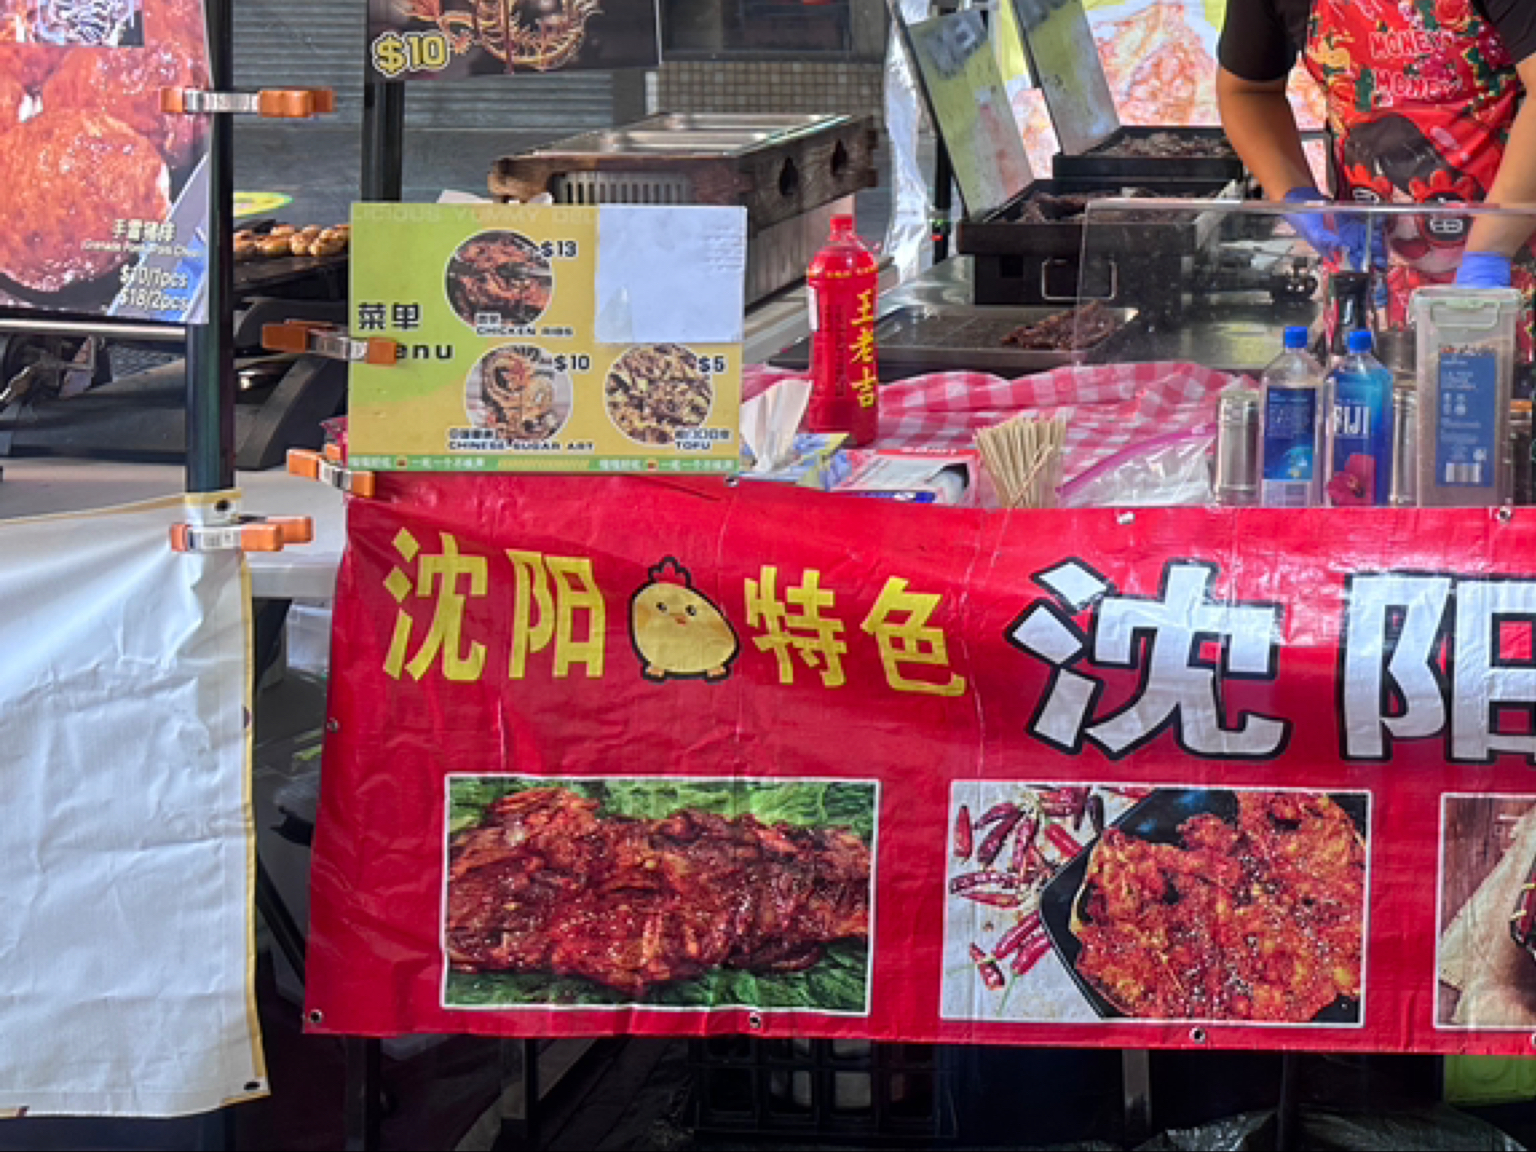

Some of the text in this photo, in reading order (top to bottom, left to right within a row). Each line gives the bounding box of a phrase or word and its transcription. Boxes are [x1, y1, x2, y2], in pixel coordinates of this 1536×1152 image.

[374, 34, 448, 78] $10
[540, 240, 578, 259] $13
[553, 355, 590, 371] $10
[850, 288, 877, 409] 王老吉
[698, 359, 726, 374] $5
[1333, 406, 1373, 435] FIJI
[382, 526, 967, 698] 沈阳 特色
